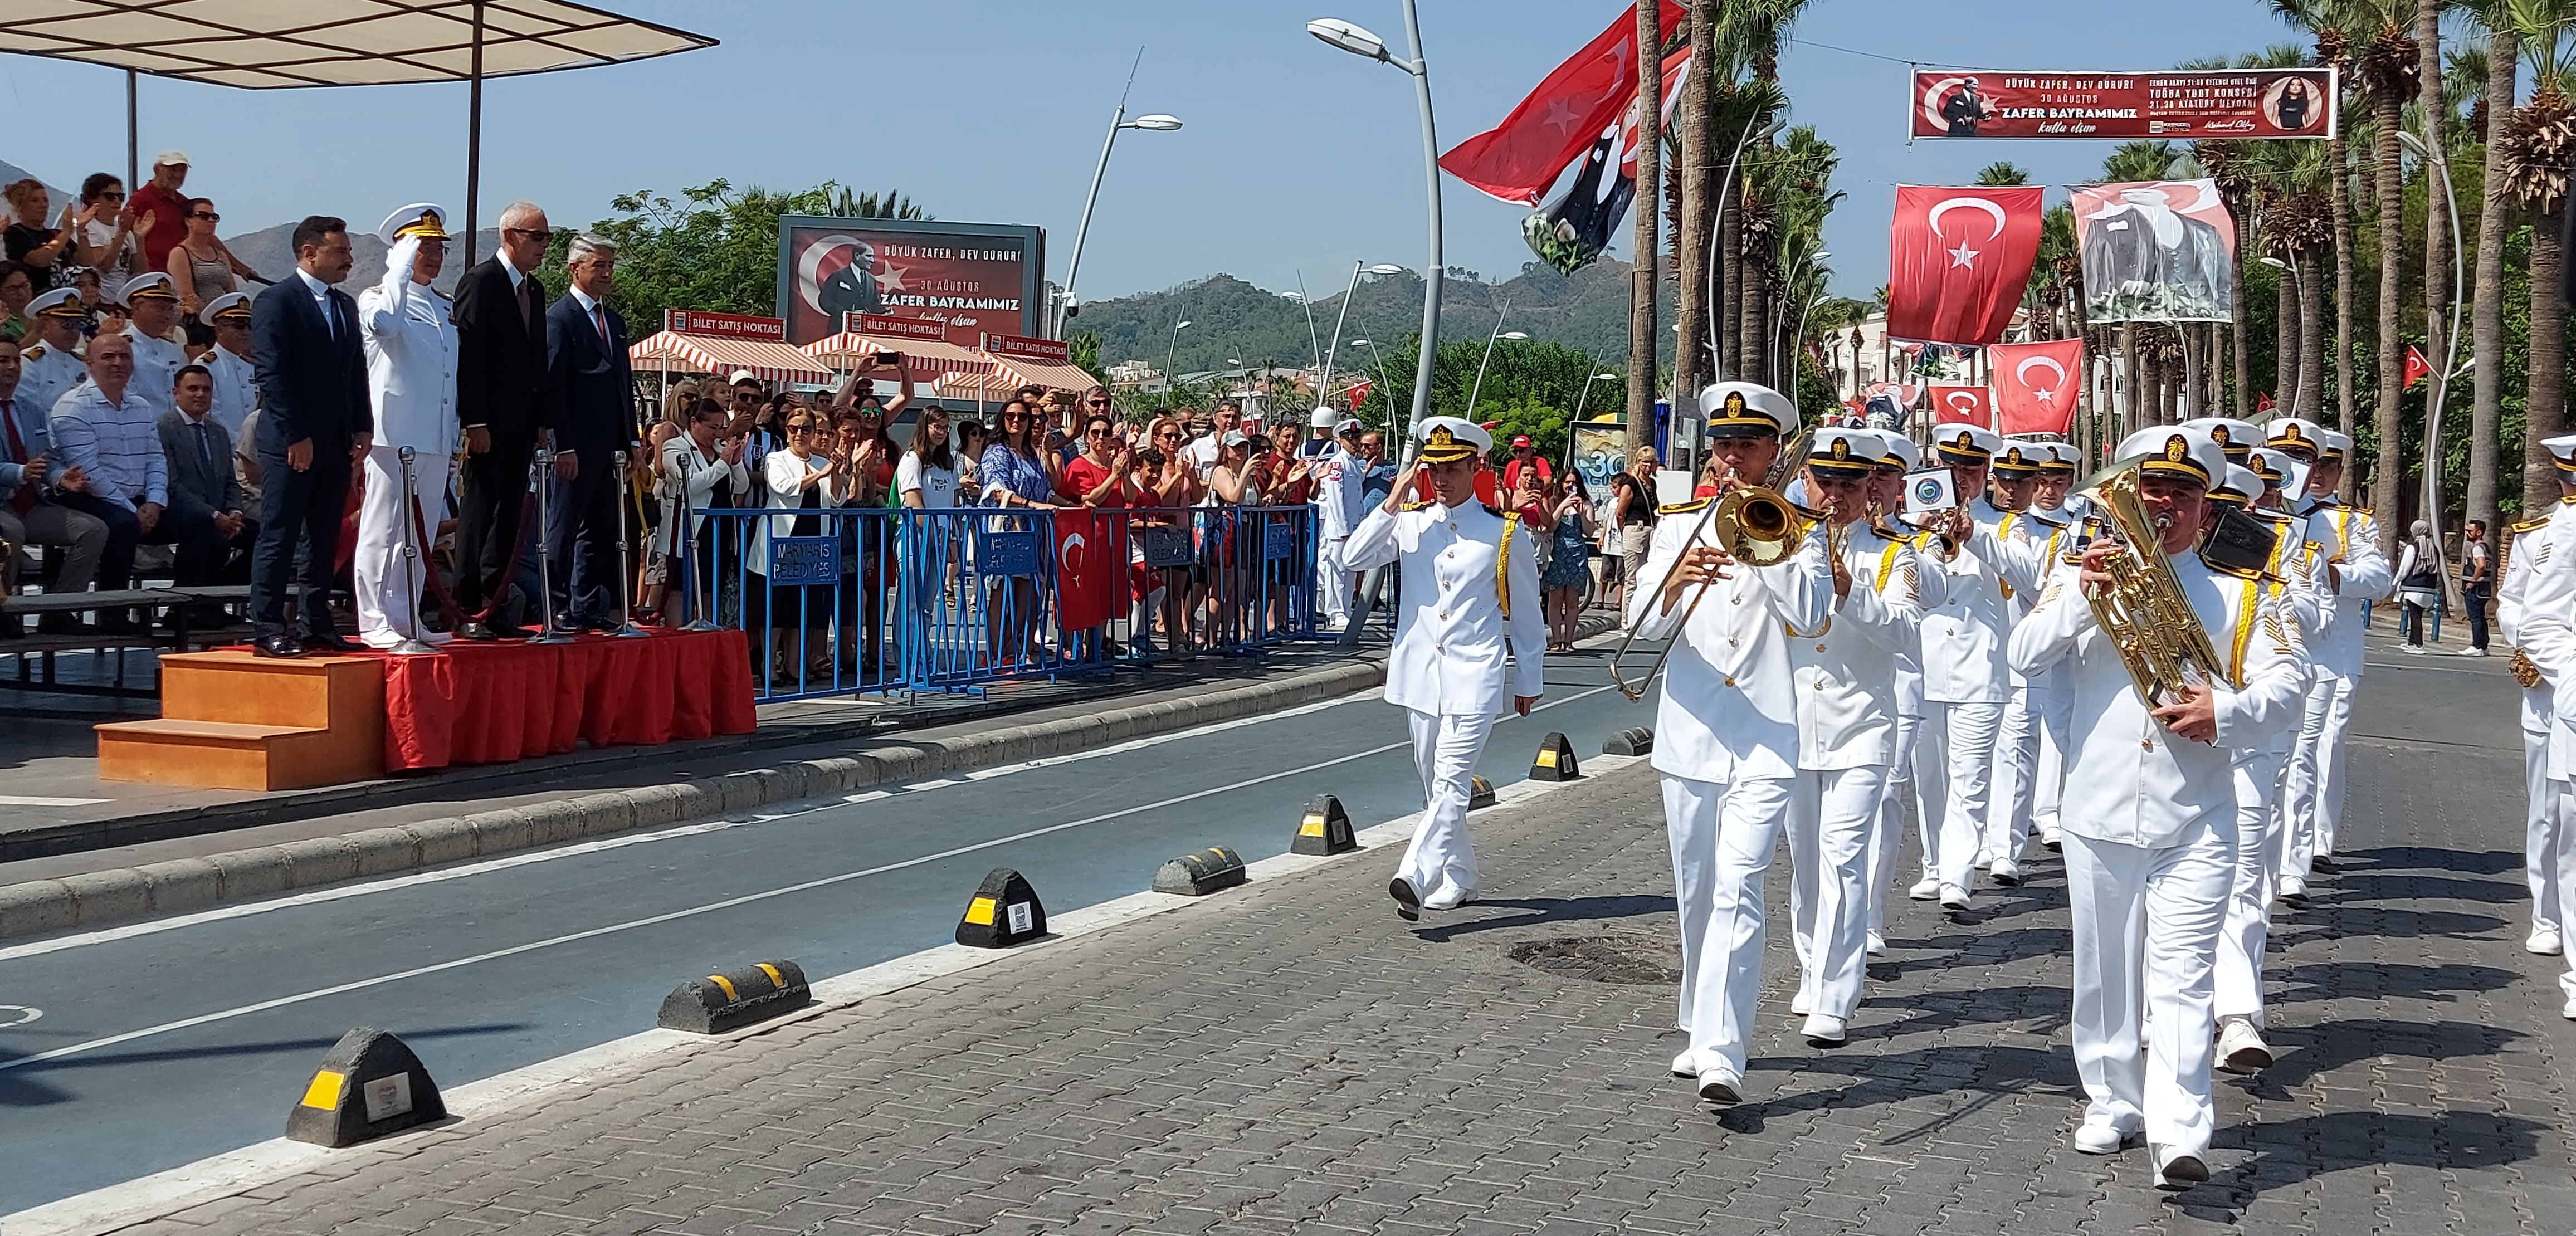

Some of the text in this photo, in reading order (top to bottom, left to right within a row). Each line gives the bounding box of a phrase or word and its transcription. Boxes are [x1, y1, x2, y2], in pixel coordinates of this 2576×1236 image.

[2005, 78, 2134, 90] BÜYÜK ZAFER, DEV GURUR!
[2041, 93, 2098, 104] 30 AĞUSTOS
[2002, 108, 2046, 118] ZAFER
[2050, 108, 2138, 118] BAYRAMIMIZ
[2038, 121, 2097, 134] kutlu olsun
[885, 245, 1021, 262] BÜYÜK ZAFER, DEV GURUR!
[921, 279, 979, 292] 30 AĞUSTOS
[881, 294, 1020, 311] ZAFER BAYRAMIMIZ
[693, 315, 780, 334] BİLET SATIŞ NOKTASI
[867, 317, 940, 335] BİLET SATIŞ NOKTASI
[950, 313, 977, 326] olsun
[1006, 339, 1066, 356] BİLET SATIŞ NOKTASI
